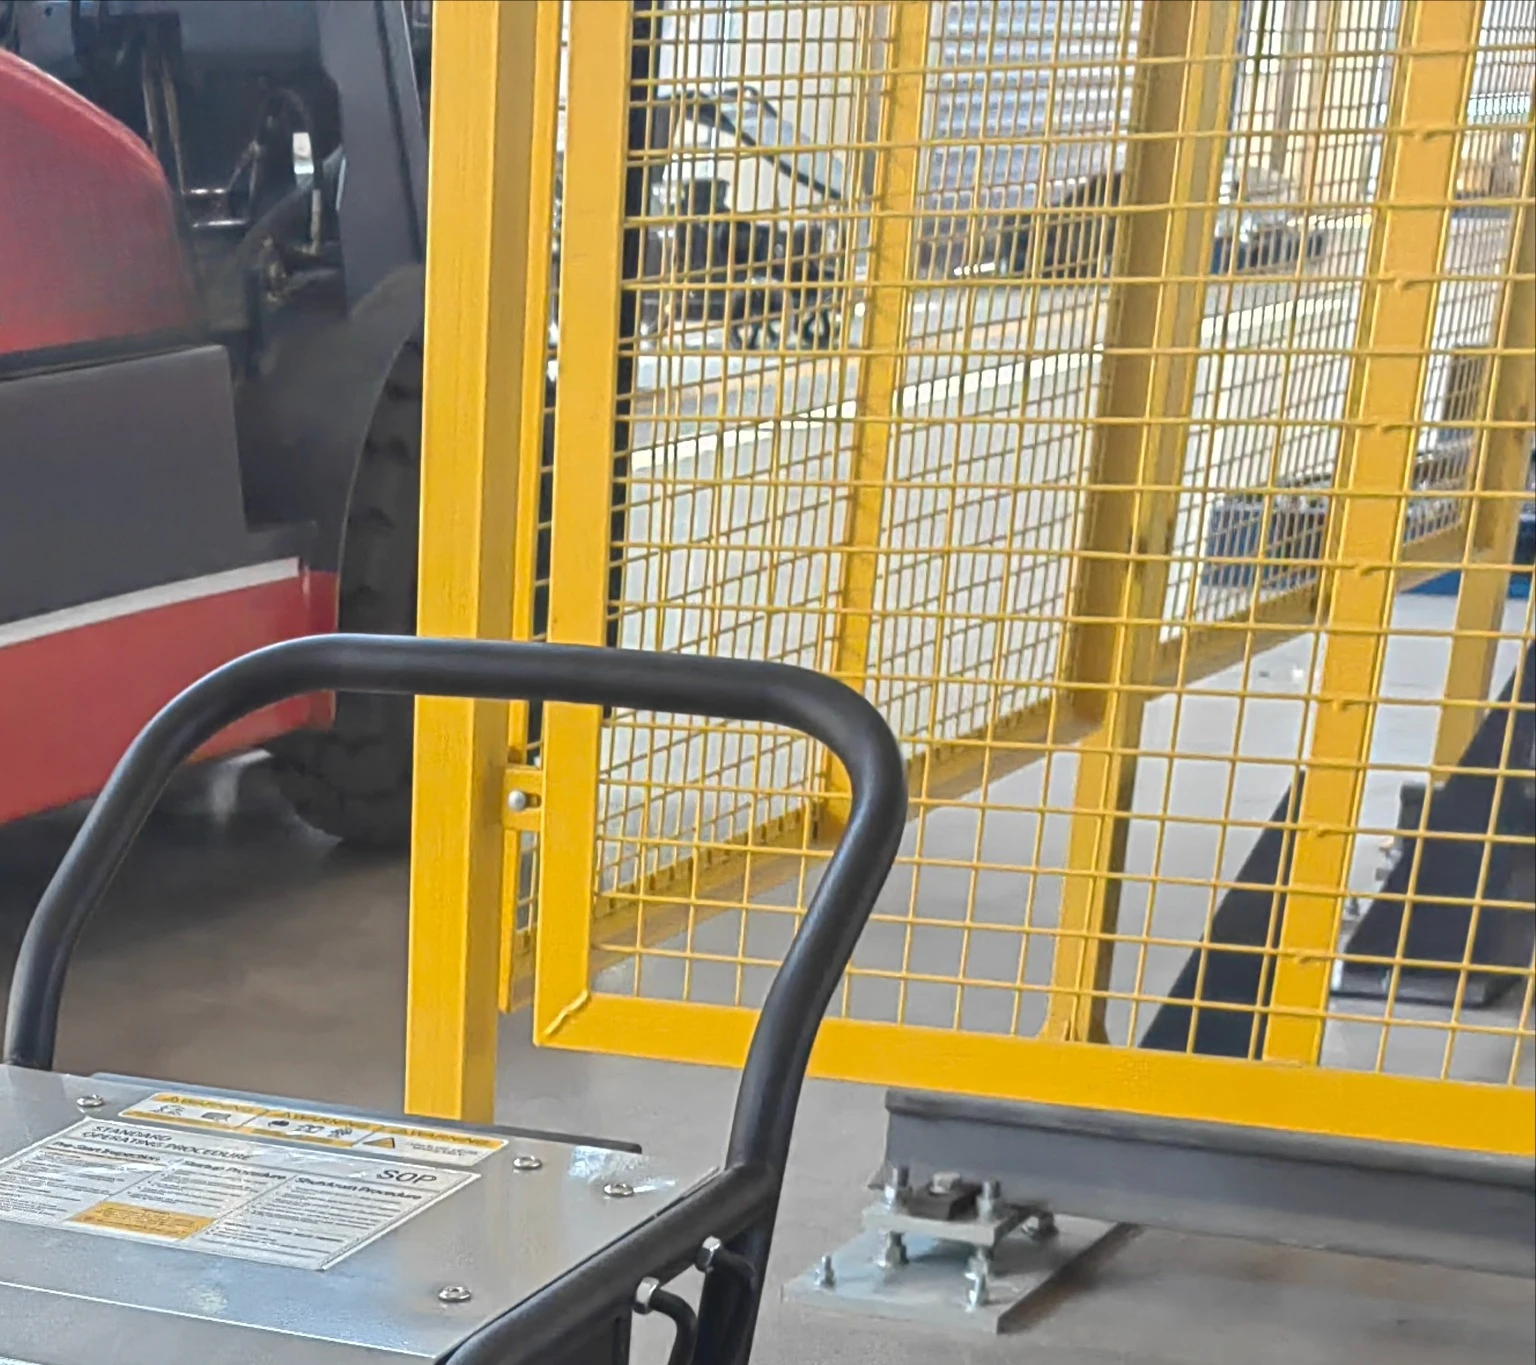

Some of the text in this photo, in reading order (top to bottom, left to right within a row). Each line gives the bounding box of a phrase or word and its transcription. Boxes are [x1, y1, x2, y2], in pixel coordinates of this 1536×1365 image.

[94, 1125, 173, 1141] STANDARD
[82, 1131, 251, 1161] OPERATING PROCEDURE
[376, 1169, 438, 1184] SOP
[358, 1186, 422, 1200] Procedure
